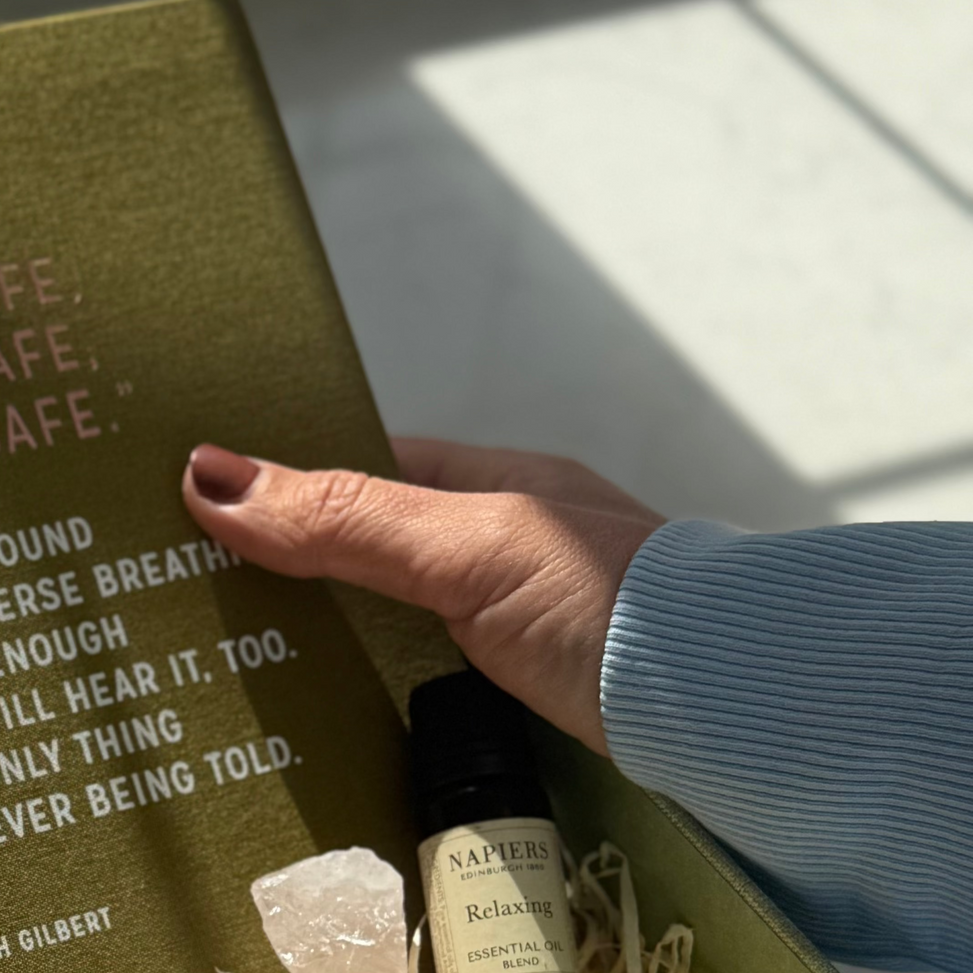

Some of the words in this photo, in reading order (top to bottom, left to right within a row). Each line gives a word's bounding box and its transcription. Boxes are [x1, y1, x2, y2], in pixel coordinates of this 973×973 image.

[63, 661, 160, 714] HEAR
[168, 649, 212, 687] IT,
[217, 628, 298, 674] TOO.
[72, 708, 183, 765] THING
[85, 760, 195, 818] BEING
[203, 735, 303, 787] TOLD.
[448, 841, 549, 872] NAPIERS
[460, 864, 523, 881] EDINBURGH
[464, 896, 553, 923] Relaxing
[18, 906, 112, 952] GILBERT
[467, 942, 541, 963] ESSENTIAL
[544, 940, 565, 951] OIL
[502, 957, 540, 969] BLEND
